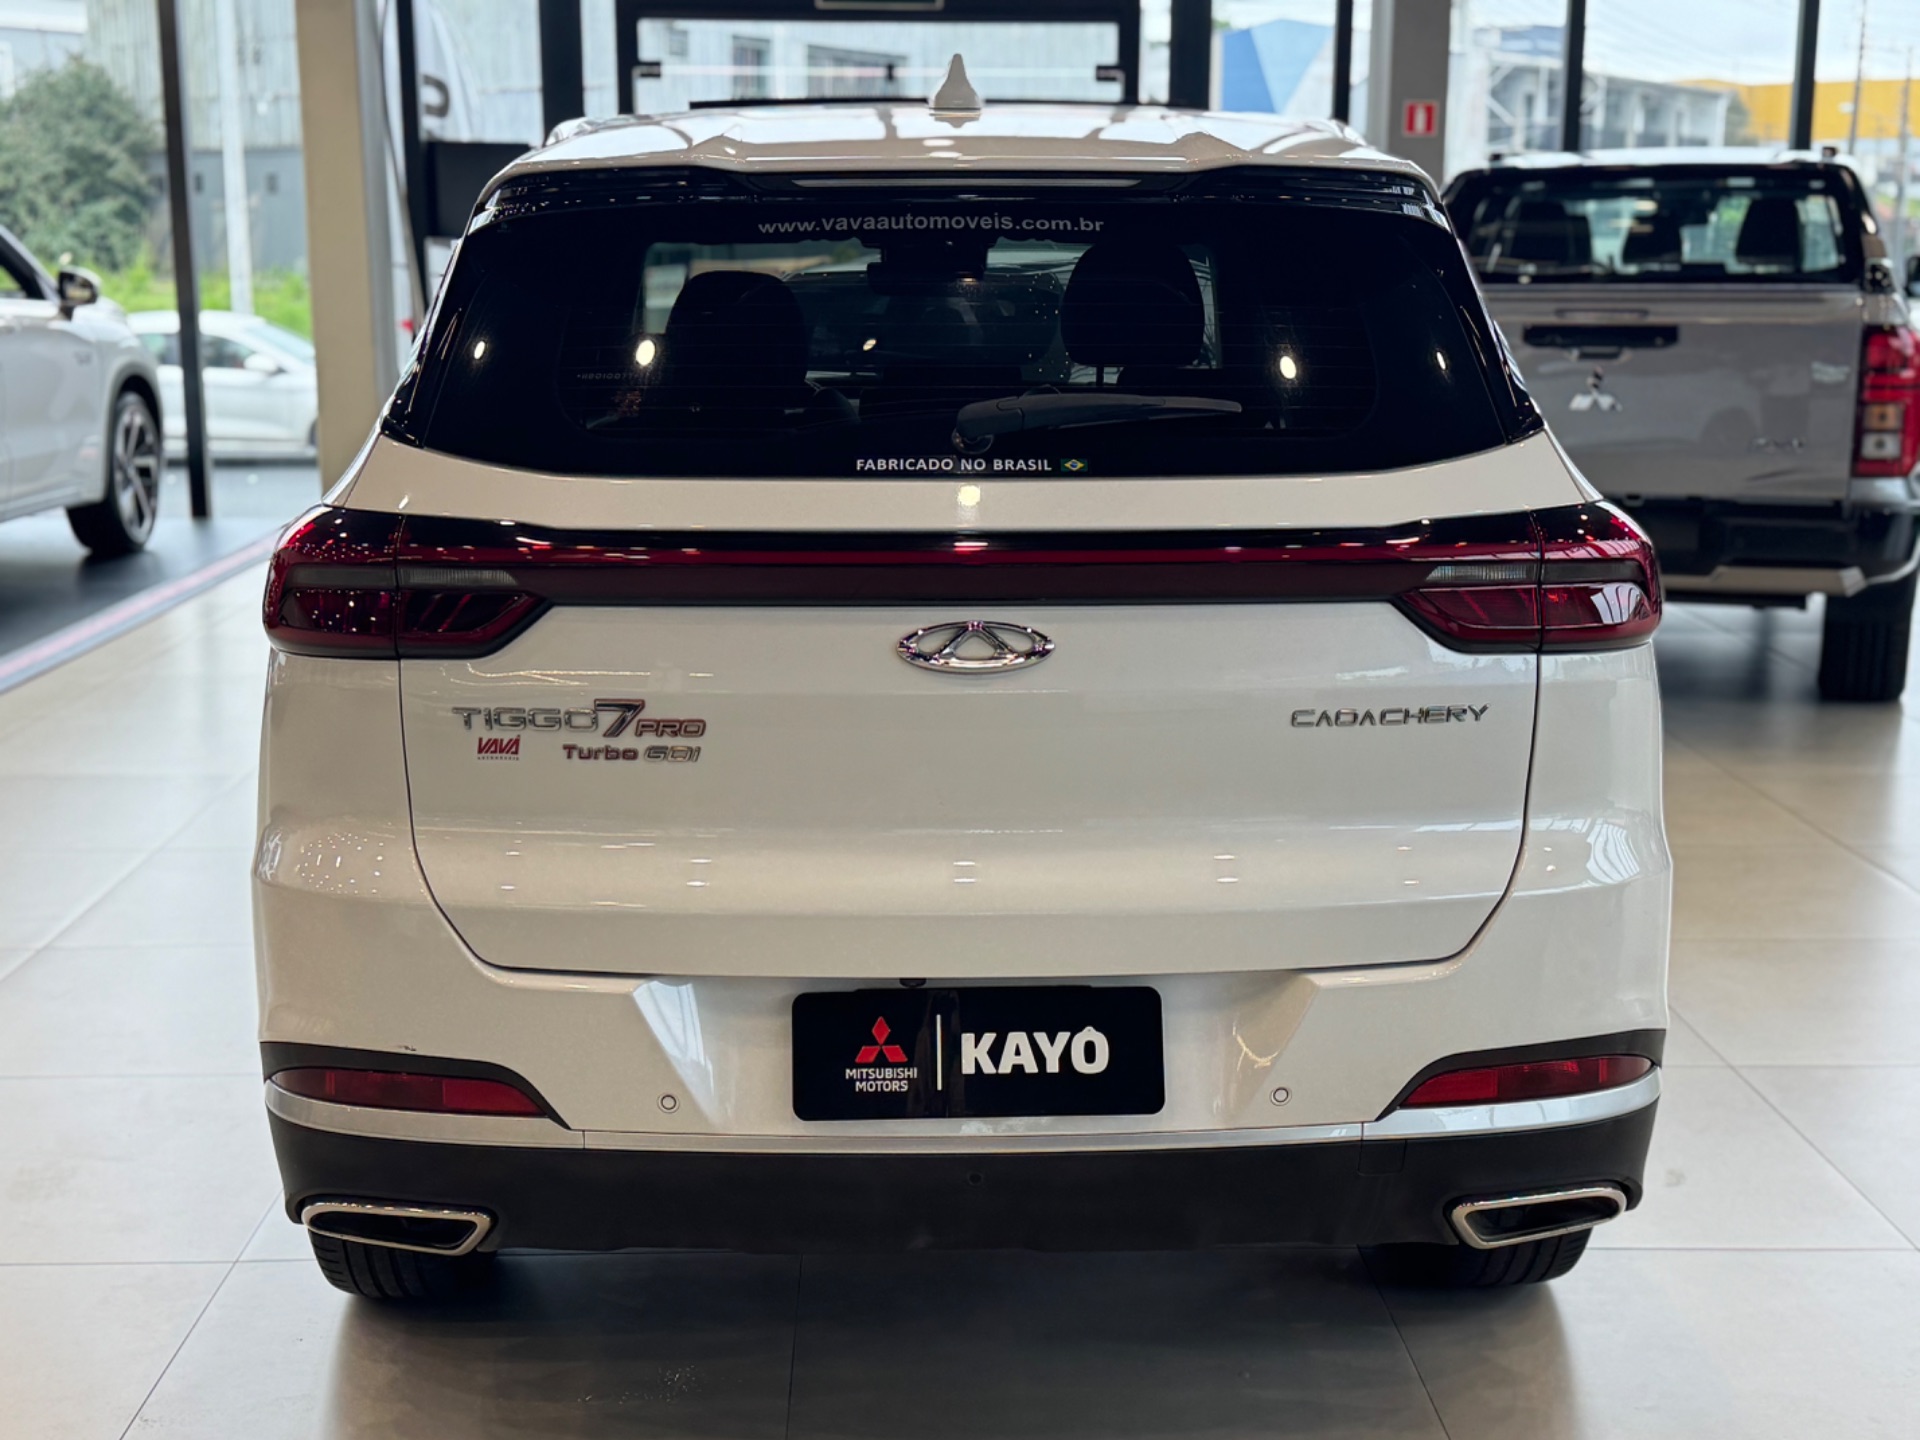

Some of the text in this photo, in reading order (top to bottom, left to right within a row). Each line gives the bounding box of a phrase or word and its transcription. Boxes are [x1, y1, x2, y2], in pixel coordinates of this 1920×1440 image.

[758, 212, 1104, 233] www.vavaautomoveis.com.br
[856, 458, 1052, 471] FABRICADO NO BRASIL
[477, 734, 521, 755] VAVÁ
[563, 744, 639, 761] Turbo
[961, 1026, 1109, 1074] KAYÔ
[845, 1067, 918, 1080] MITSUBISHI
[855, 1080, 909, 1092] MOTORS
